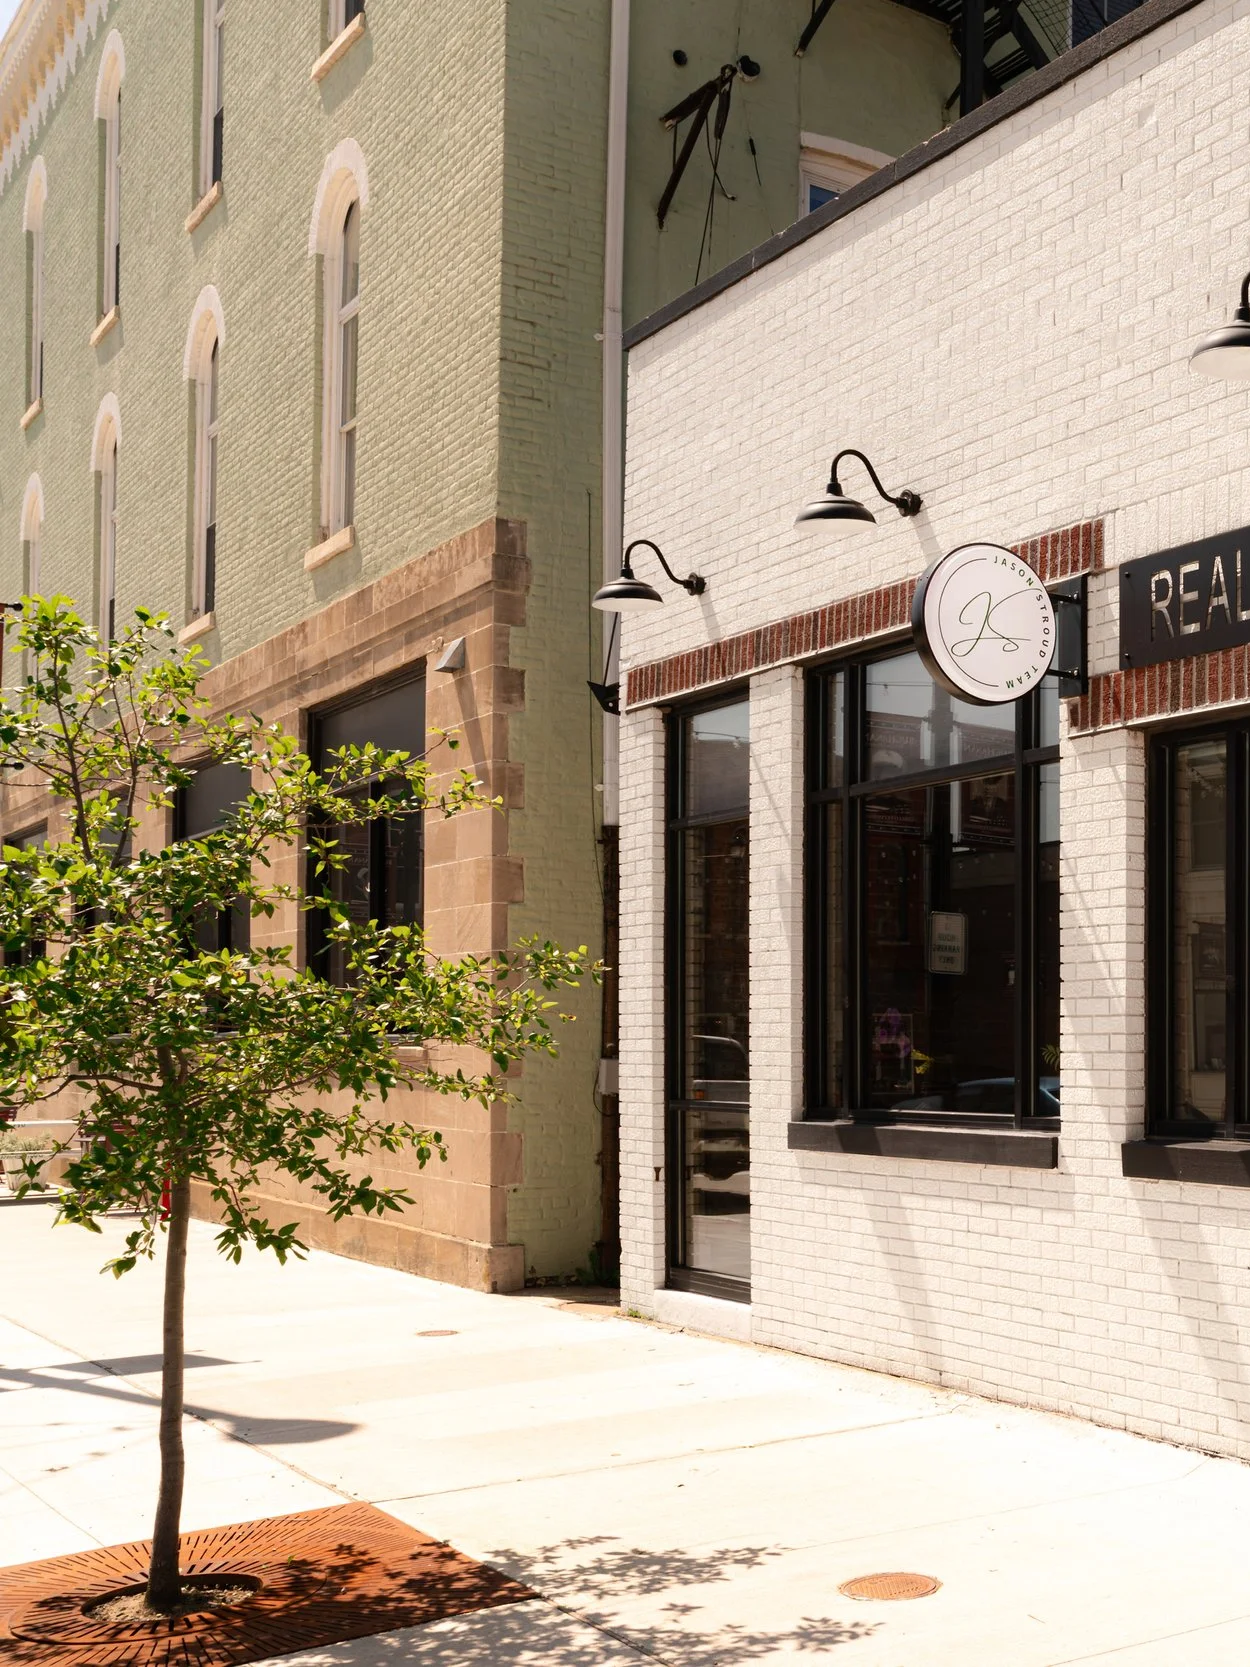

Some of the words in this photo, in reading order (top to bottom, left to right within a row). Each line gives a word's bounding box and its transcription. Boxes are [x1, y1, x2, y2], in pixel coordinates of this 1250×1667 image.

[994, 555, 1034, 587] JASON
[1035, 594, 1050, 659] STROUD
[1006, 665, 1038, 689] TEAM
